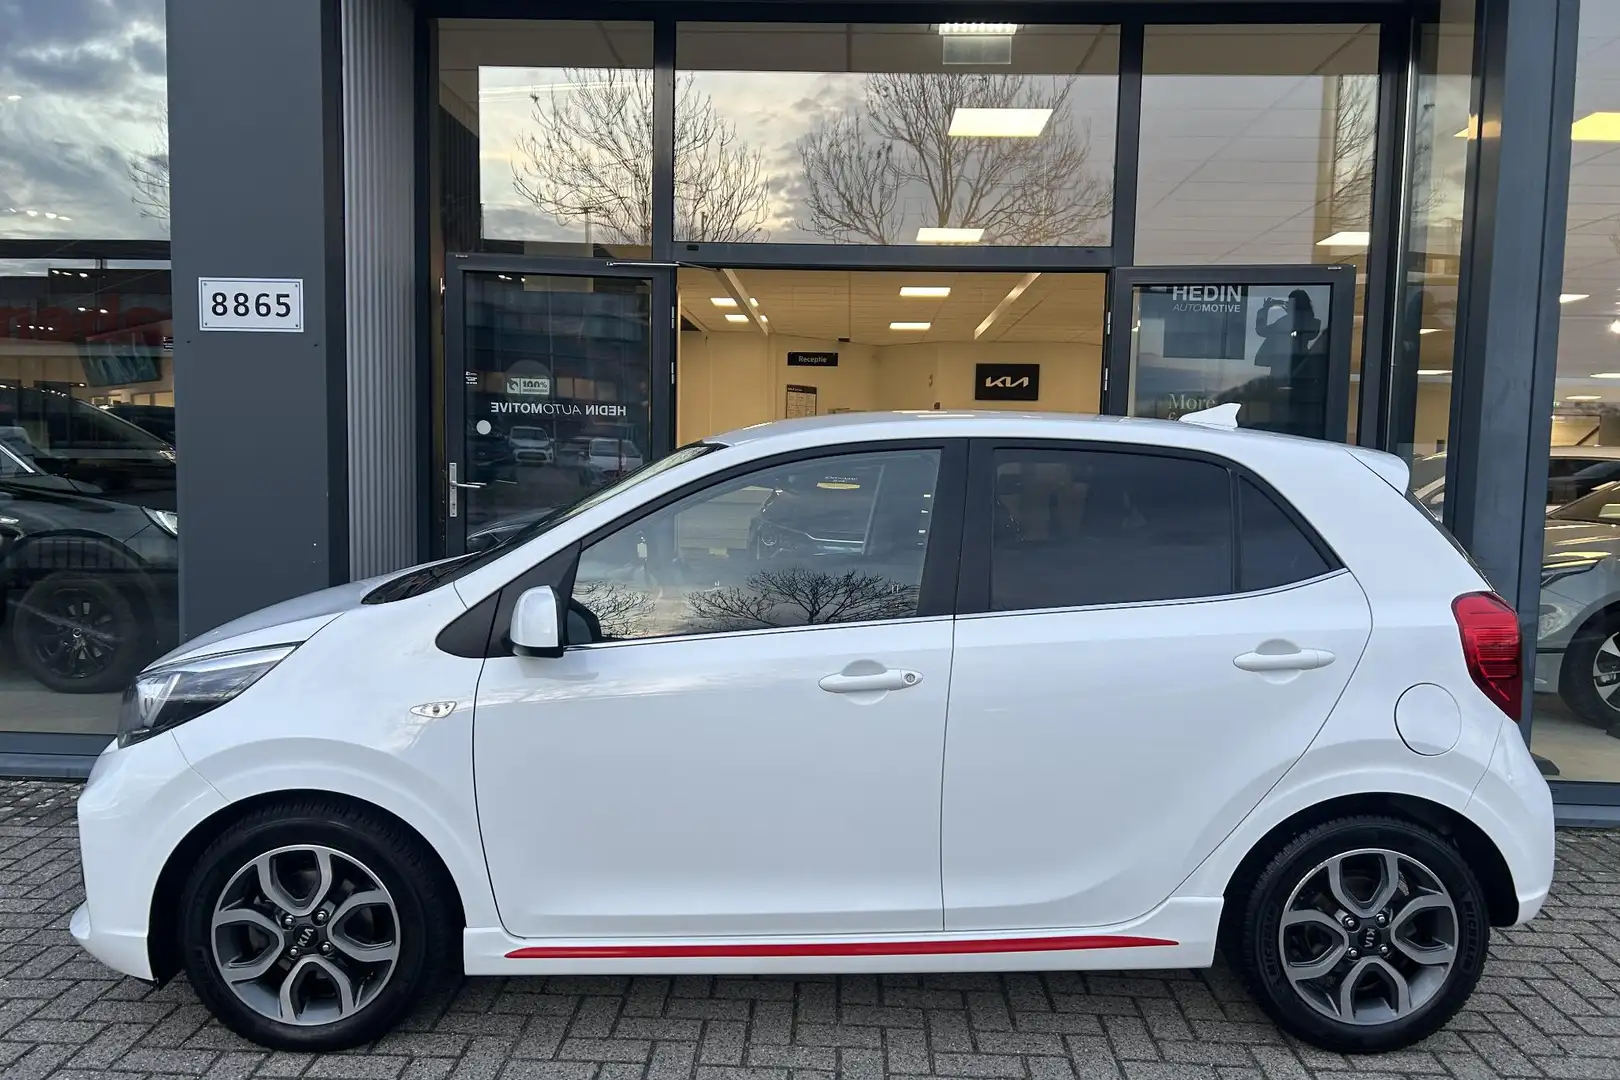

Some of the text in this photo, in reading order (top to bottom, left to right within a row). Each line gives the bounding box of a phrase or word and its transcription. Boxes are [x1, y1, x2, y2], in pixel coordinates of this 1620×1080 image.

[1172, 285, 1242, 302] HEDIN
[211, 292, 291, 317] 8865
[1172, 303, 1241, 313] AUTOMOTIVE
[798, 355, 828, 364] Receptie
[1168, 393, 1216, 410] More
[297, 928, 314, 947] KIA
[1363, 928, 1376, 947] KIA
